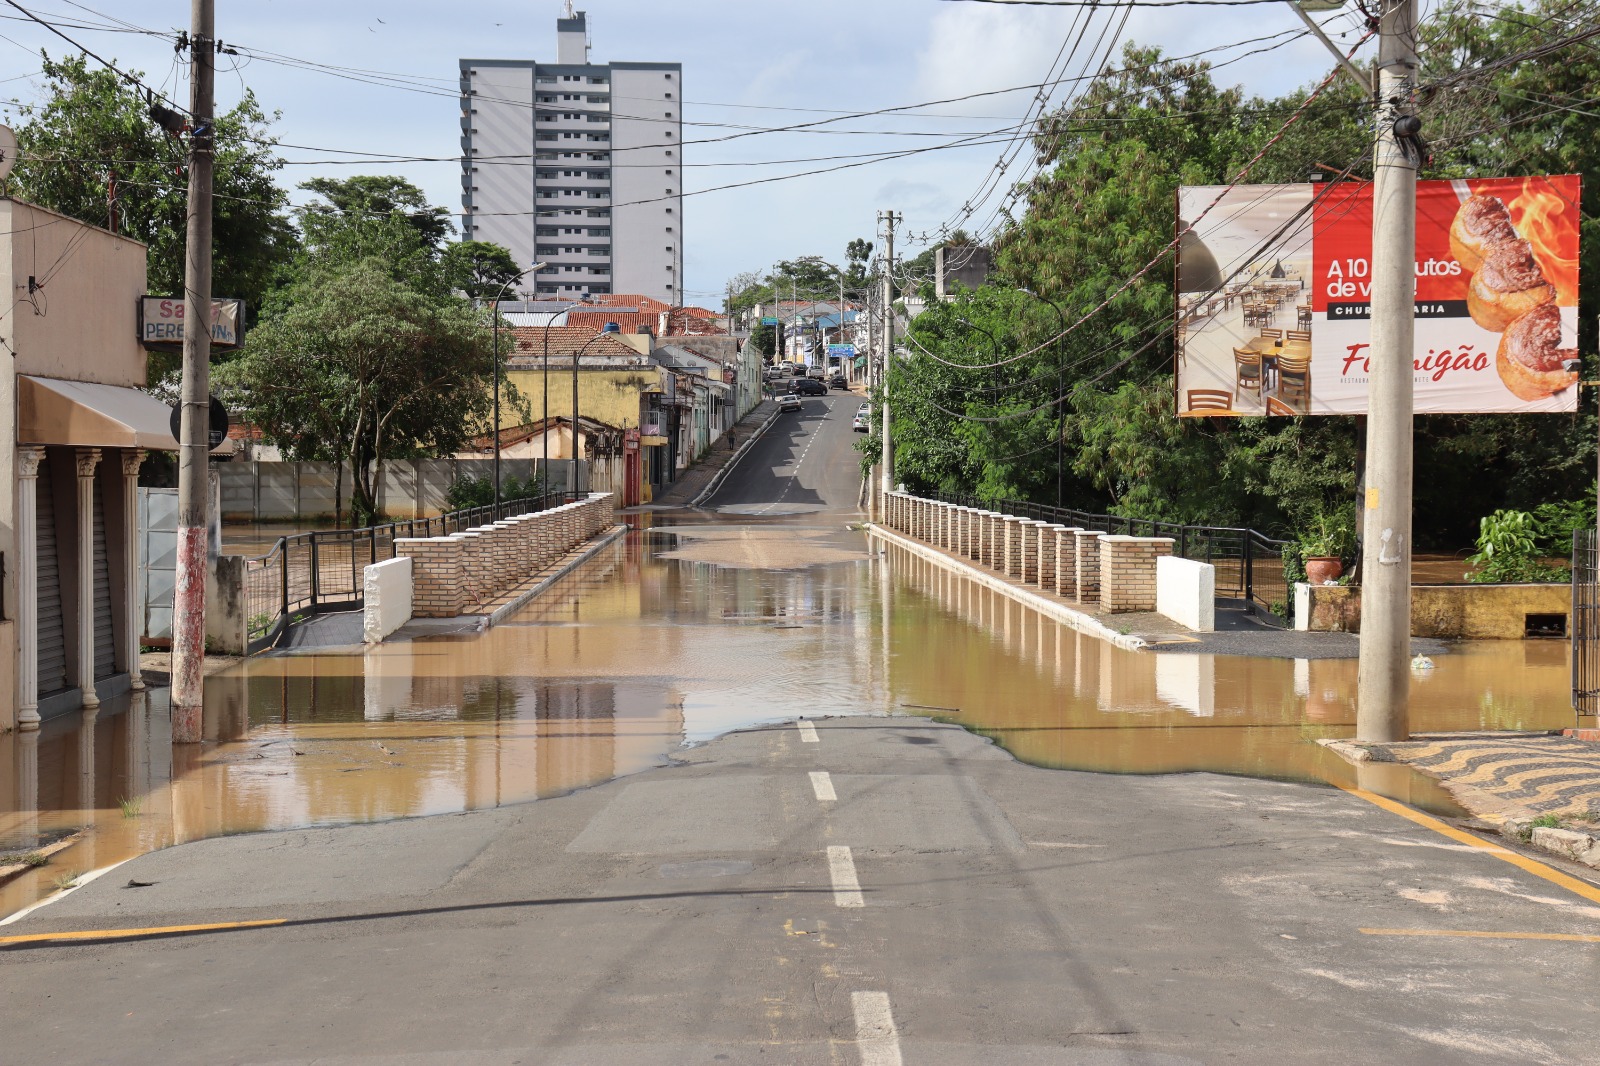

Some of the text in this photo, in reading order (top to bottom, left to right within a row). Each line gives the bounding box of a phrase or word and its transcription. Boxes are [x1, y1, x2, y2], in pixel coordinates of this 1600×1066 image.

[1327, 259, 1344, 279] A
[1346, 258, 1368, 278] 10
[1327, 277, 1356, 297] de
[1335, 304, 1445, 315] CHURARIA
